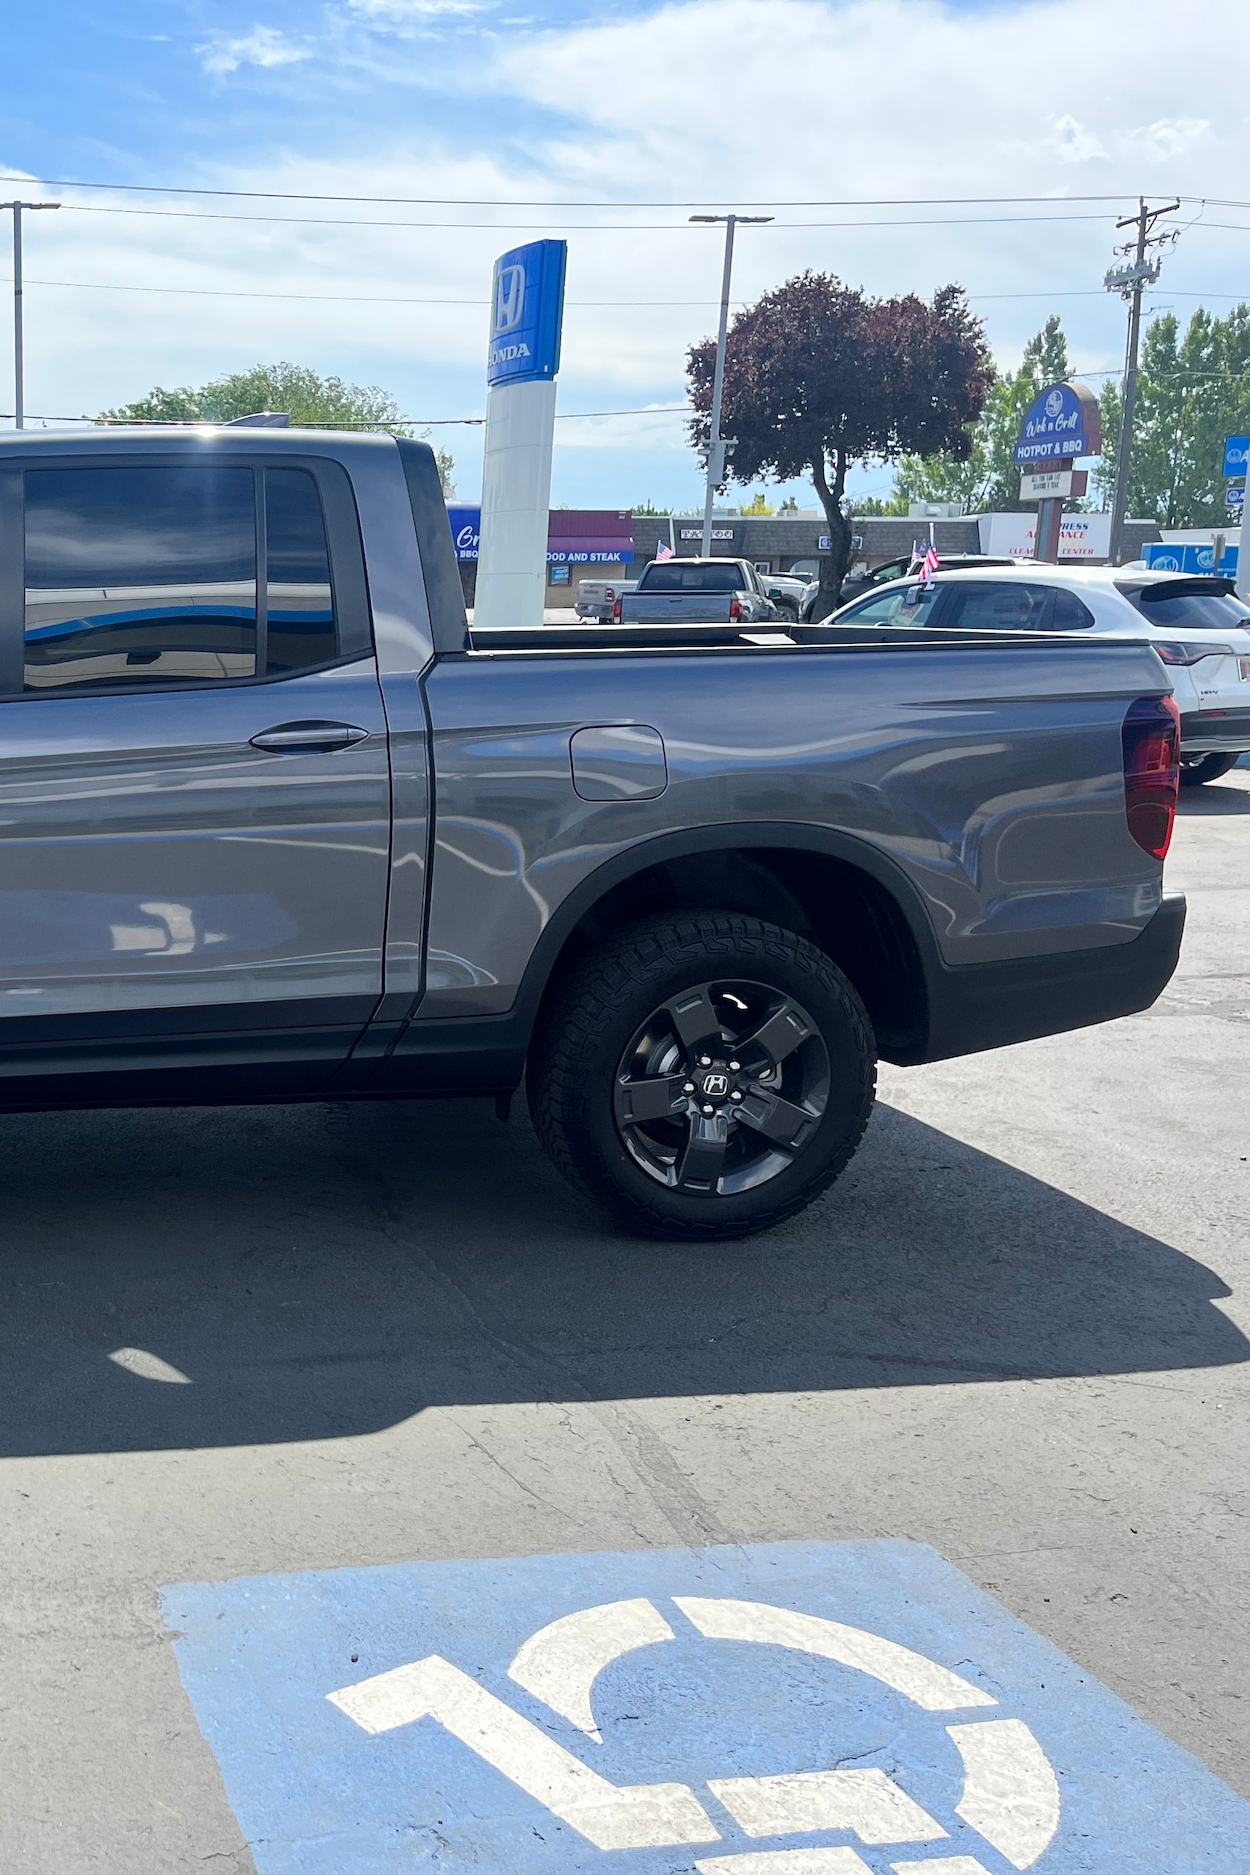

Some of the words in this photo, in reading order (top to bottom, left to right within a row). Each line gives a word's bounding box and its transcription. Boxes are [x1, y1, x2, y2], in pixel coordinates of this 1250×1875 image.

[1055, 411, 1078, 431] Grill
[1018, 443, 1053, 458] HOTPOT
[1054, 442, 1061, 454] &
[1063, 439, 1082, 453] BBQ
[682, 530, 732, 538] TAOO
[459, 550, 478, 559] BBQ
[567, 551, 588, 562] AND
[589, 551, 621, 562] STEAK
